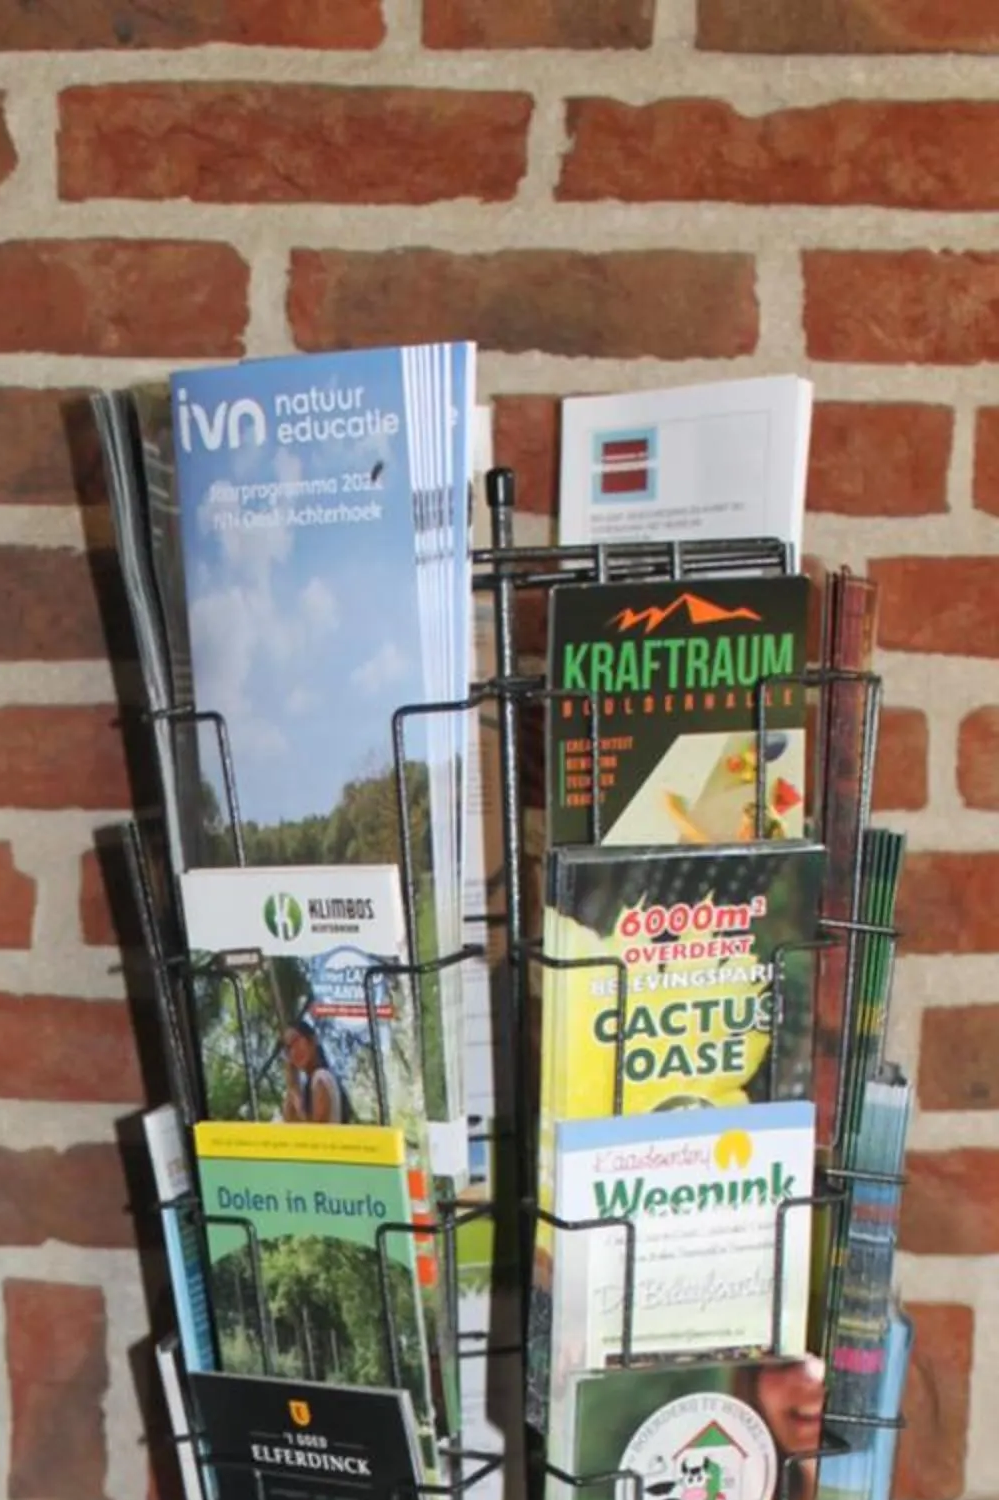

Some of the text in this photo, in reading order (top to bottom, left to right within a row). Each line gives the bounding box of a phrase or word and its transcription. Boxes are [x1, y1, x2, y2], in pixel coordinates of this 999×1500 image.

[274, 385, 365, 417] natuur
[177, 387, 267, 453] ivn
[276, 410, 400, 445] educatie
[562, 633, 794, 694] KRAFTRAUM
[307, 897, 375, 921] KLIMBOS
[625, 935, 756, 964] OVERDEKT
[591, 962, 784, 997] BEEVINGSPARK
[594, 992, 784, 1043] CACTUS
[625, 1039, 746, 1082] OASE
[217, 1185, 388, 1219] Dolen in Ruurlo
[593, 1162, 797, 1219] Weenink
[250, 1444, 372, 1477] ELFERDINCK
